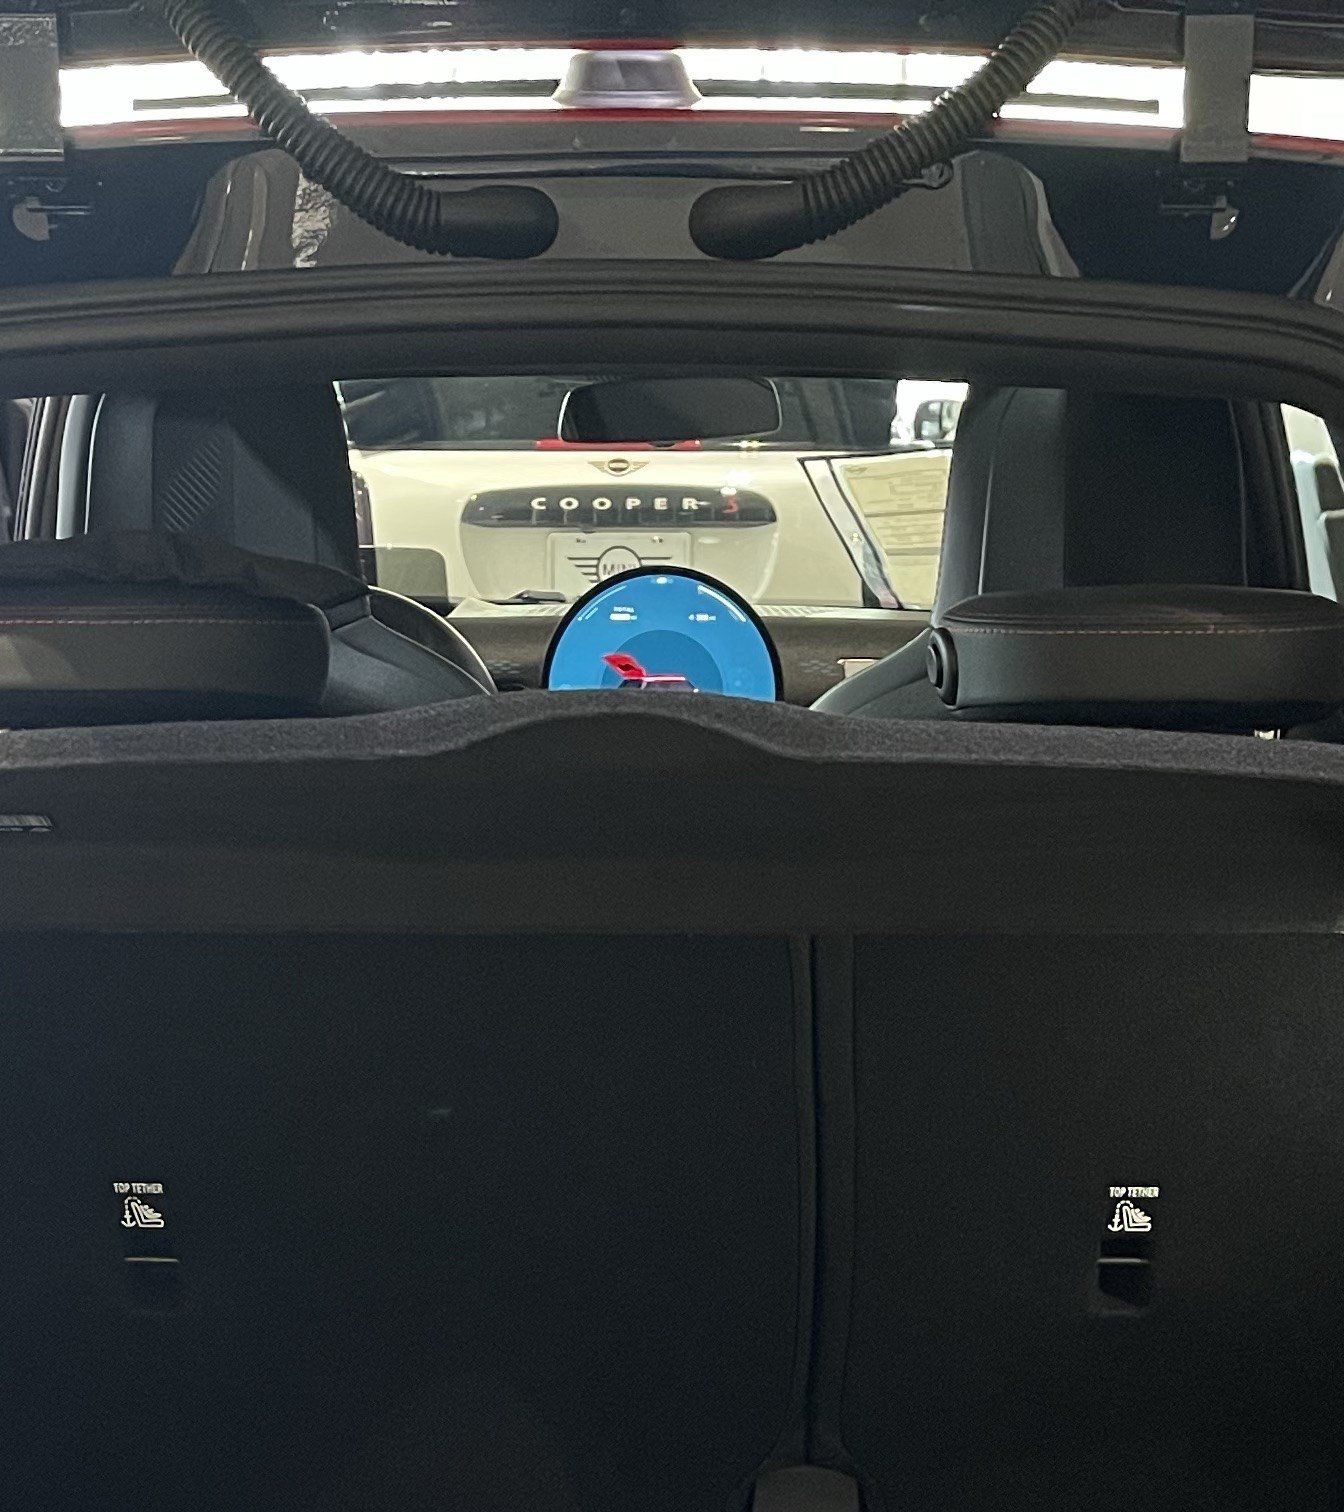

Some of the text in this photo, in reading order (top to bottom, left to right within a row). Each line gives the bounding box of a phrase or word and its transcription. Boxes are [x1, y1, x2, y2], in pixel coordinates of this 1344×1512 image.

[530, 497, 699, 510] COOPER
[113, 1182, 164, 1194] TOP TETHER
[1109, 1186, 1159, 1198] TOP TETHER
